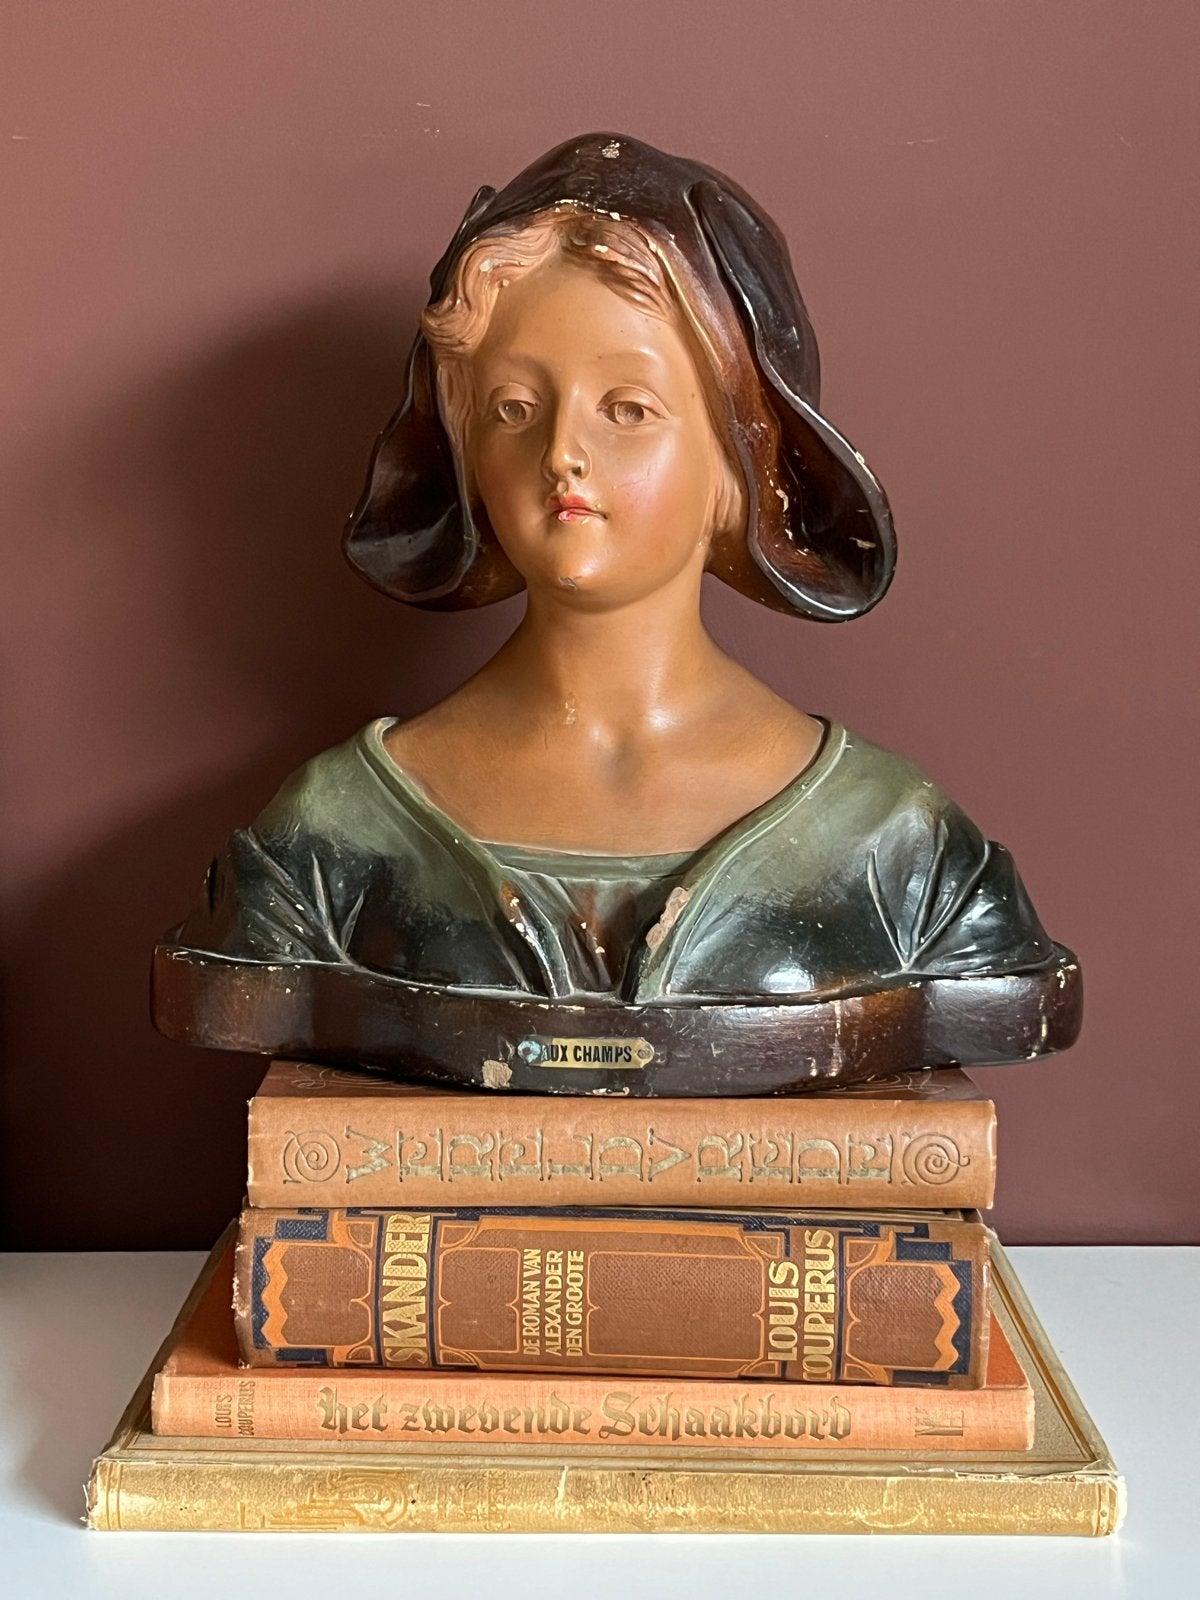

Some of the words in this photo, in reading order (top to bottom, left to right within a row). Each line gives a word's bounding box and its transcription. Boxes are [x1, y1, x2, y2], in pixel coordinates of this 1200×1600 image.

[573, 1045, 633, 1063] CHAMPS
[523, 1248, 541, 1277] VAN
[523, 1280, 541, 1335] ROMAN
[545, 1250, 564, 1357] ALEXANDER
[566, 1250, 585, 1325] GROOTE
[768, 1261, 799, 1361] LOUIS
[523, 1338, 541, 1356] DE
[566, 1328, 583, 1357] DEN
[214, 1394, 233, 1429] LOUIS
[400, 1391, 593, 1435] zwevende
[599, 1392, 852, 1440] Schaakbord
